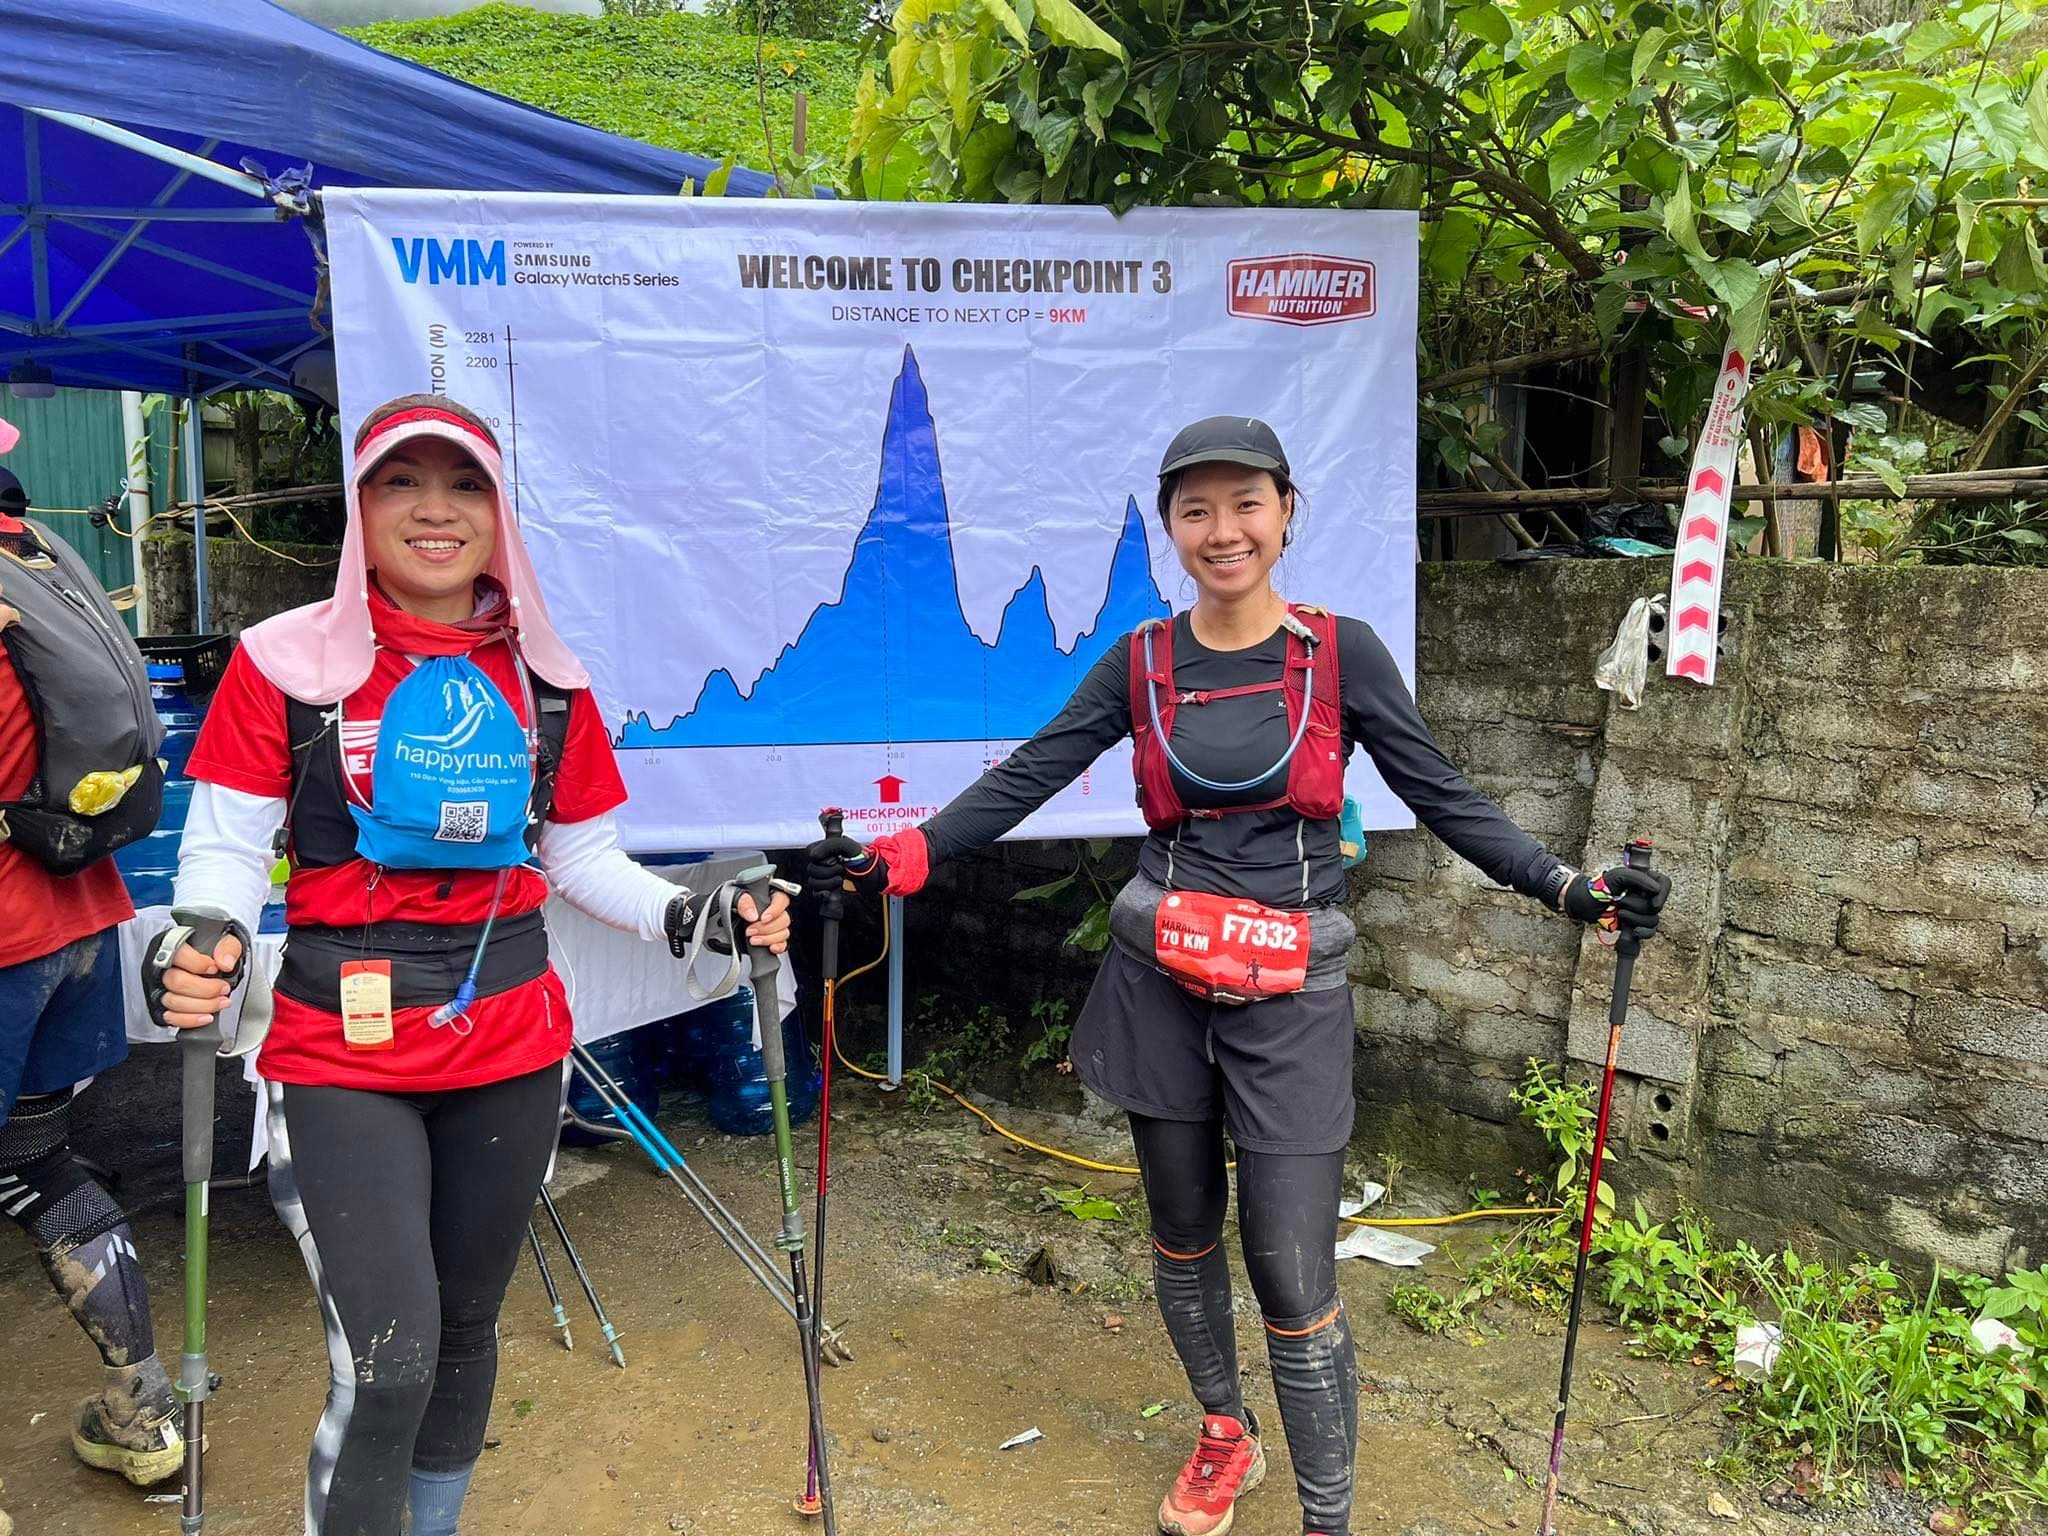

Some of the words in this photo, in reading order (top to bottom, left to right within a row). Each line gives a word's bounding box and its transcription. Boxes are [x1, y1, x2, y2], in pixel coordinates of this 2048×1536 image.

[391, 237, 507, 286] VMM
[514, 254, 591, 267] SAMSUNG
[514, 272, 570, 288] Galaxy
[571, 273, 630, 286] Watch5
[633, 274, 679, 287] Series
[738, 255, 893, 291] WELCOME
[902, 257, 941, 293] TO
[952, 258, 1142, 294] CHECKPOINT
[1152, 260, 1172, 294] 3
[1236, 269, 1366, 298] HAMMER
[832, 306, 920, 322] DISTANCE
[925, 308, 949, 322] TO
[954, 308, 1000, 323] NEXT
[1006, 308, 1030, 323] CP
[1049, 308, 1086, 323] 9KM
[1268, 300, 1342, 314] NUTRITION
[429, 324, 448, 348] (M)
[465, 332, 495, 343] 2281
[465, 356, 498, 369] 2200
[1714, 409, 1726, 434] ALLOWED
[395, 740, 528, 774] happyrun.vn
[842, 807, 928, 820] CHECKPOINT
[1161, 929, 1180, 946] 70
[1183, 932, 1210, 952] KM
[1222, 913, 1298, 951] F7332
